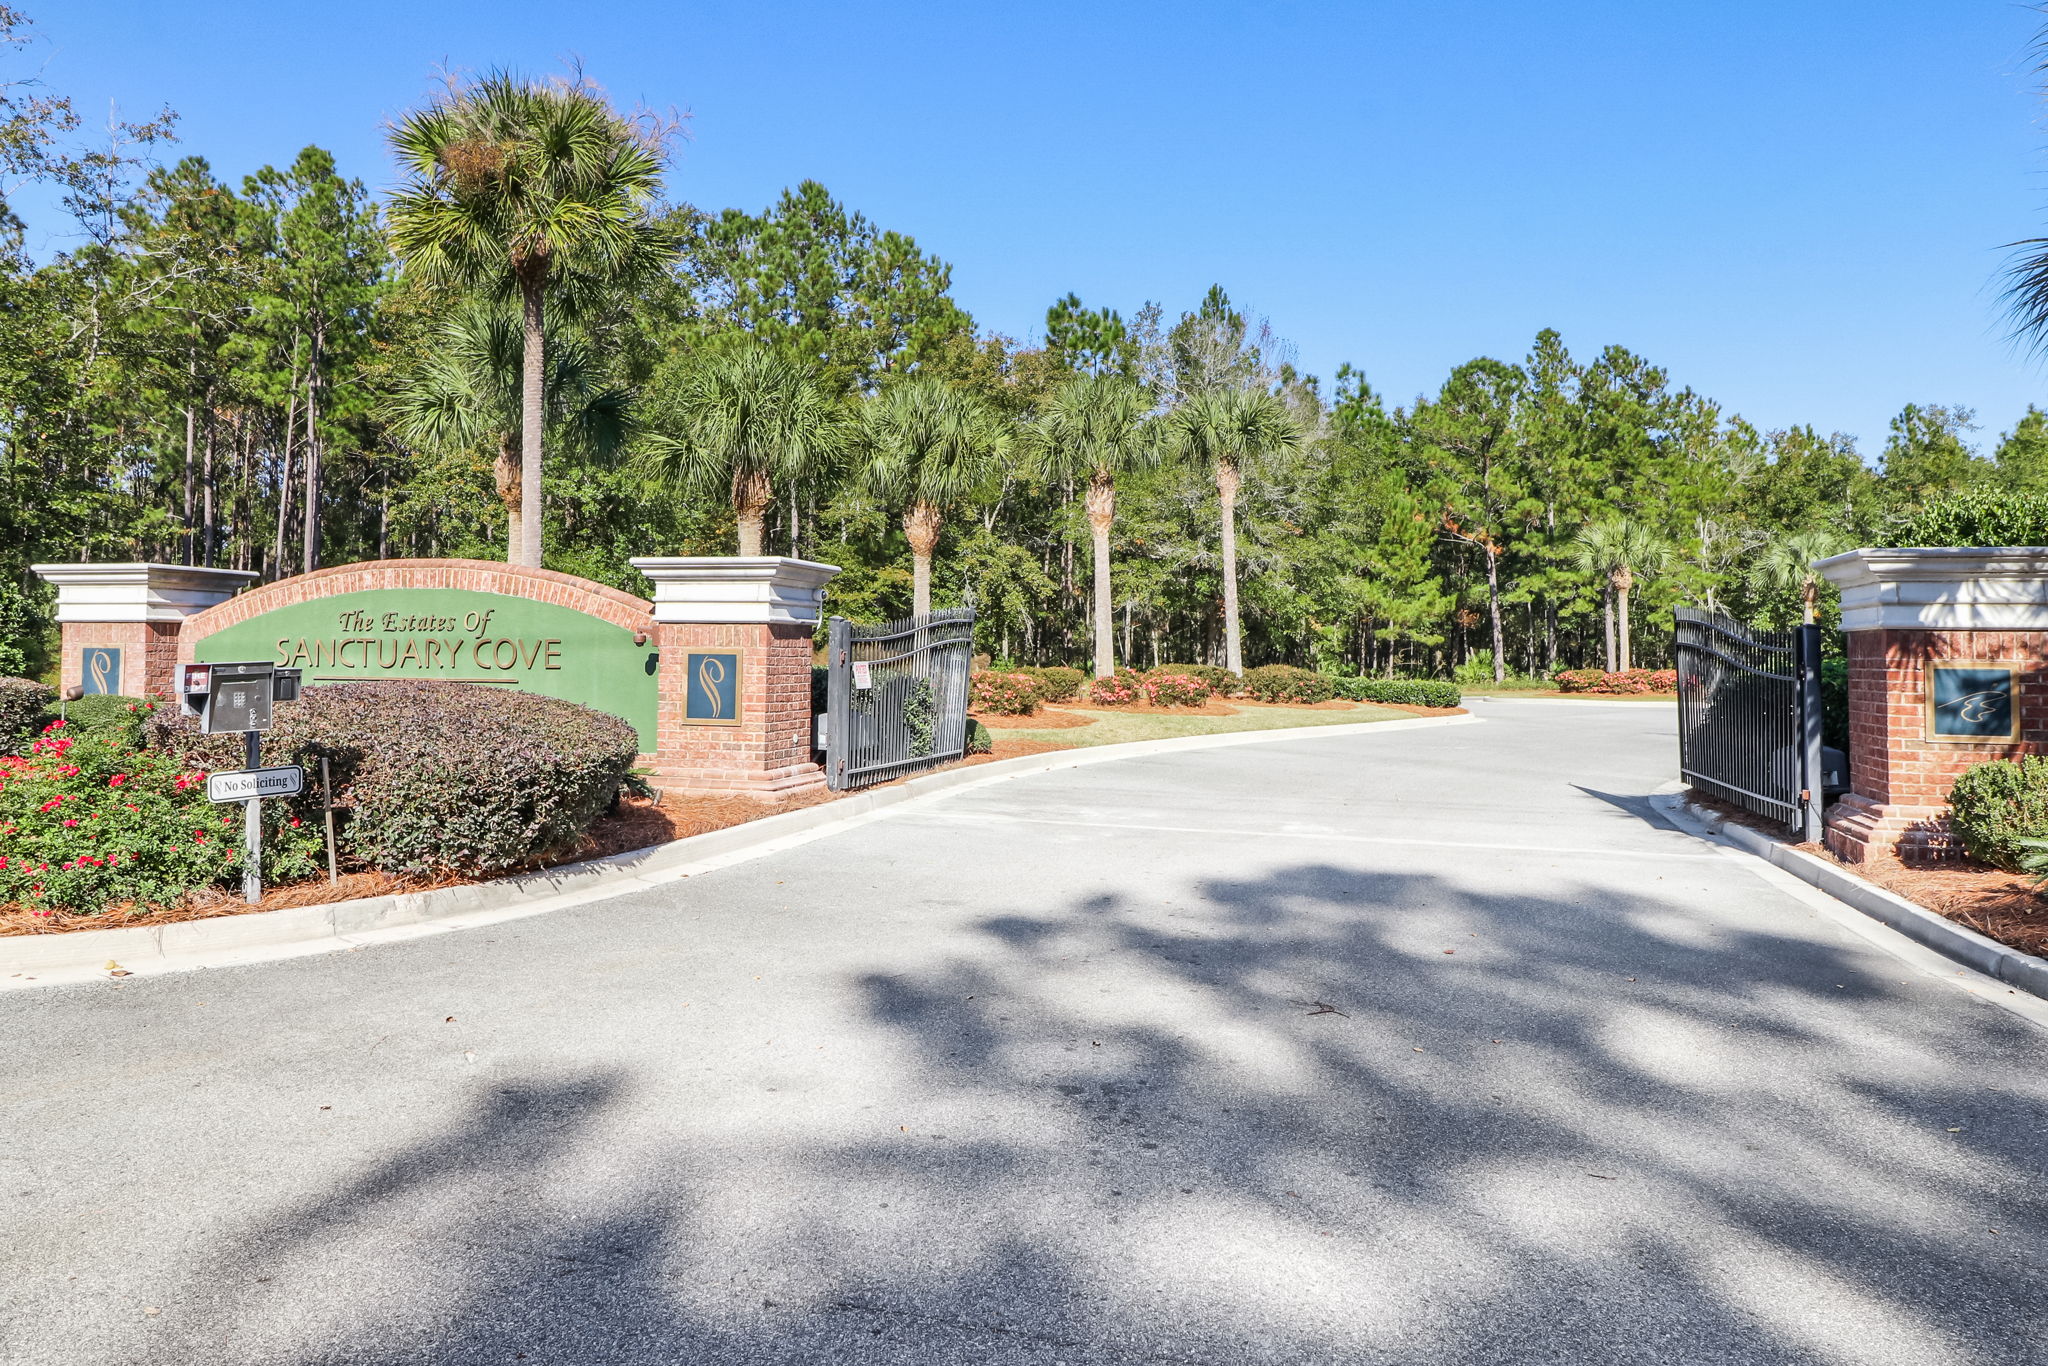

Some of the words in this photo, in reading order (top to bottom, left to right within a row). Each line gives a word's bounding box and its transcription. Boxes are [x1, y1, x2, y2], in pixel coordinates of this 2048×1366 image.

[339, 609, 374, 632] The
[381, 611, 456, 632] Estates
[463, 608, 495, 639] Of
[275, 637, 464, 670] SANCTUARY
[473, 638, 562, 670] COVE
[224, 781, 239, 792] No
[240, 776, 288, 791] Soliciting
